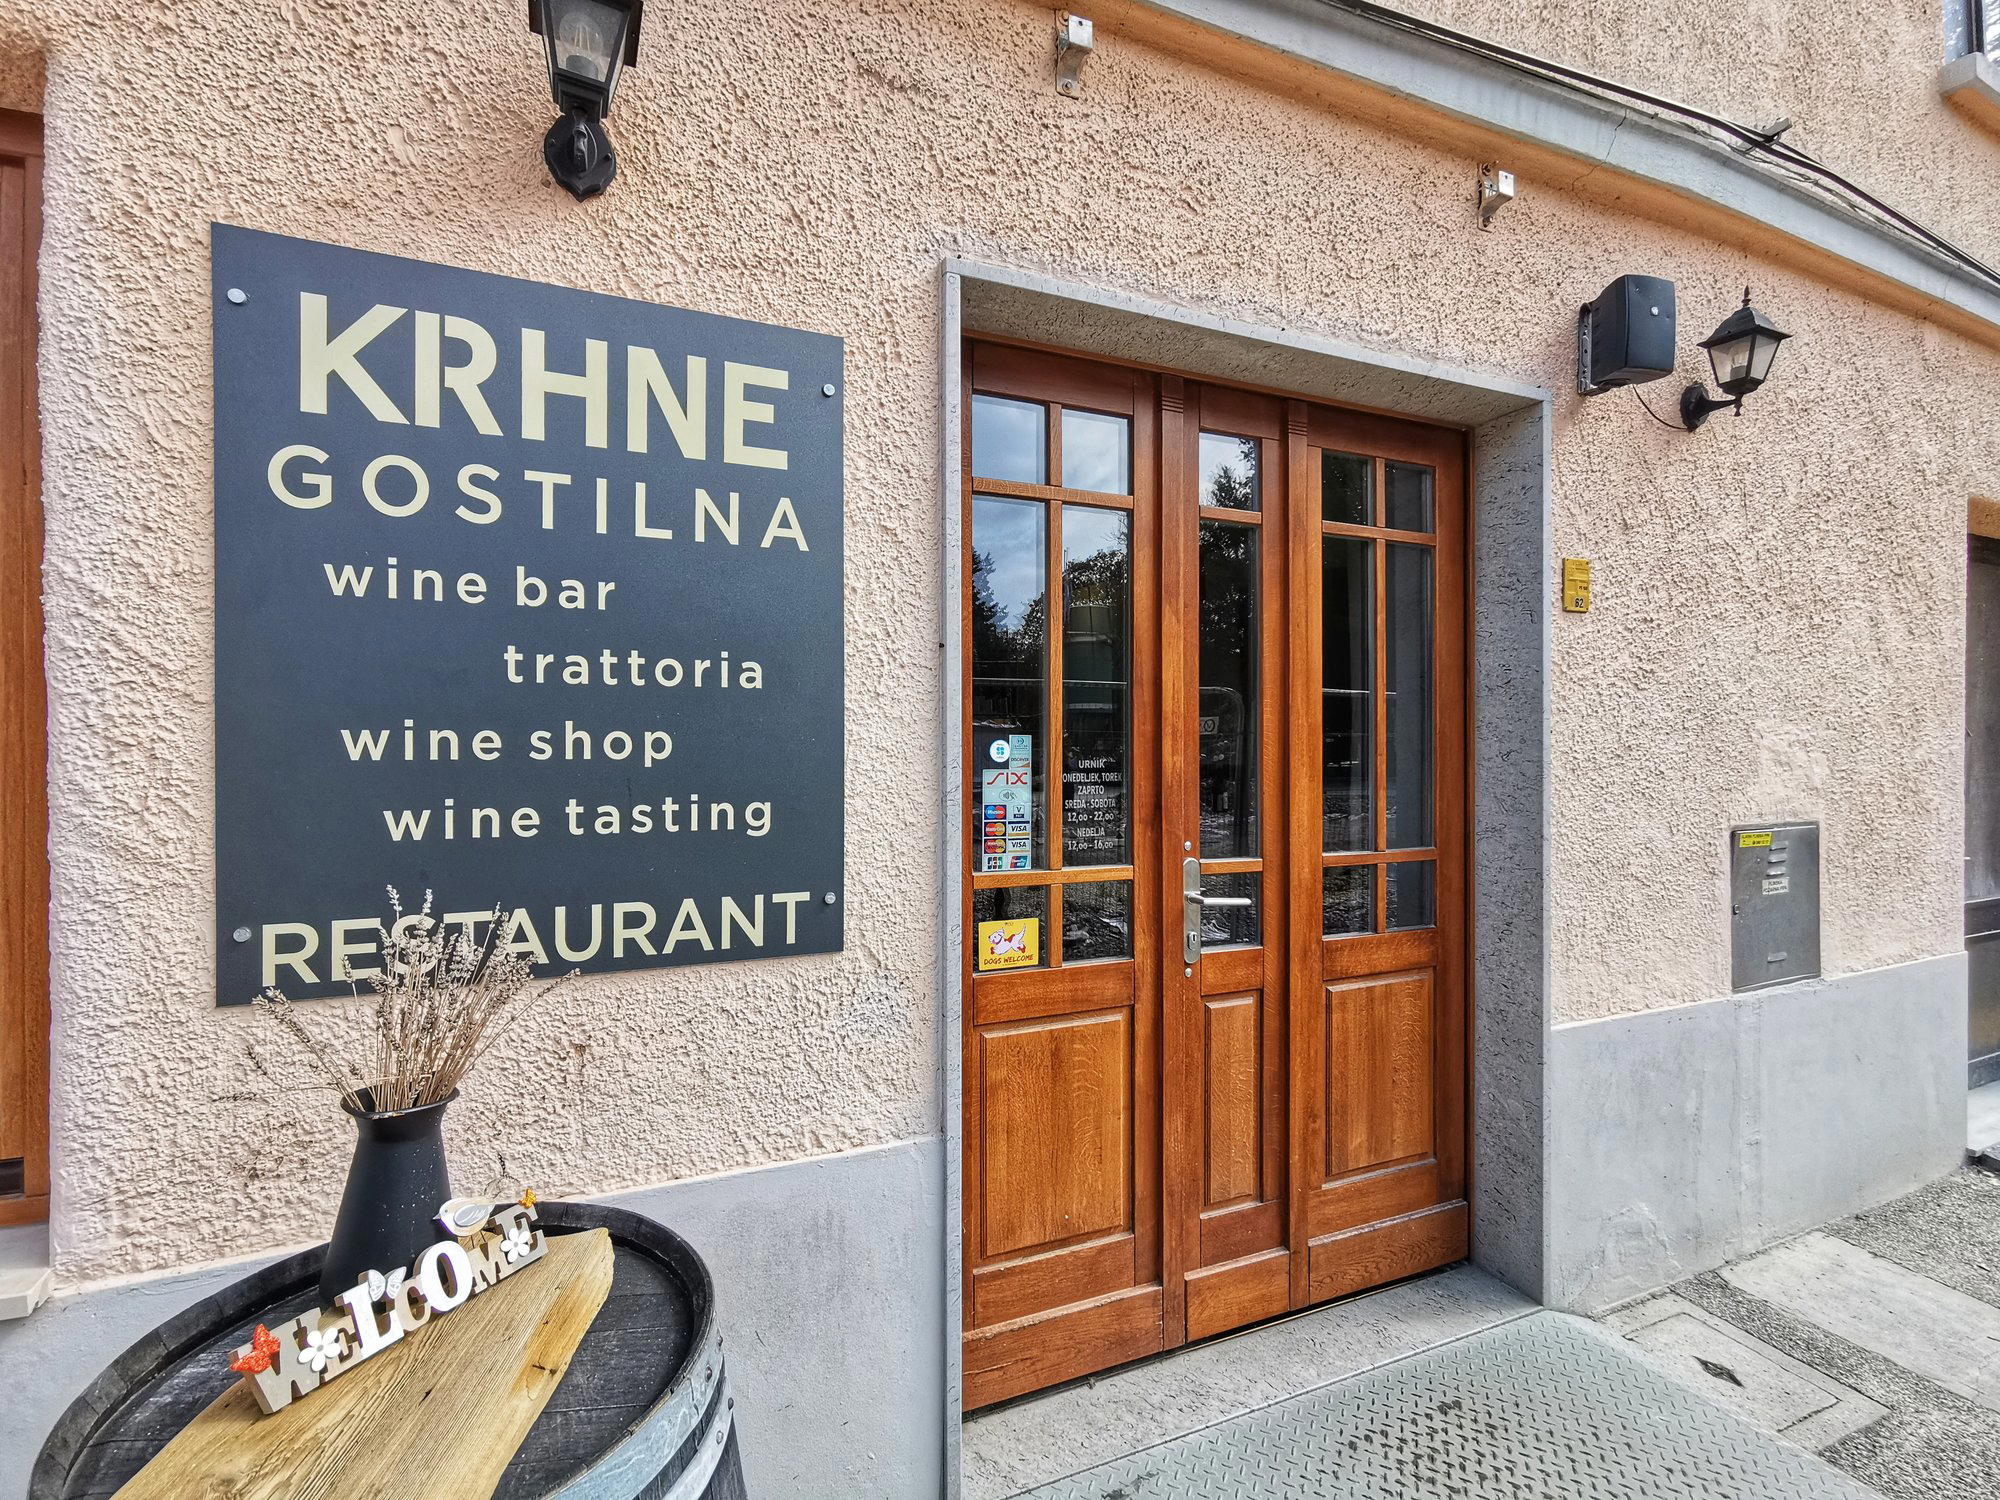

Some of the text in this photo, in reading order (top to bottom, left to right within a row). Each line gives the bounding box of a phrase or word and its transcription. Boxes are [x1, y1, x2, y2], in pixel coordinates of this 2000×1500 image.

[300, 291, 789, 471] KRHNE
[267, 444, 810, 552] GOSTILNA
[323, 557, 616, 611] wine bar
[504, 645, 764, 689] trattoria
[340, 719, 674, 767] wine shop
[1078, 759, 1106, 769] URNIK
[1062, 772, 1122, 783] ONEDELJEK, TOREK
[1077, 785, 1105, 795] ZAPRTO
[383, 794, 773, 841] wine tasting
[1064, 799, 1086, 809] SREDA
[1090, 798, 1116, 808] SOBOTA
[1077, 827, 1105, 837] NEDELJA
[261, 892, 811, 987] RESTAURANT
[983, 957, 1002, 966] DOGS
[1003, 954, 1034, 963] WELCOME
[229, 1204, 549, 1415] WELCOME
